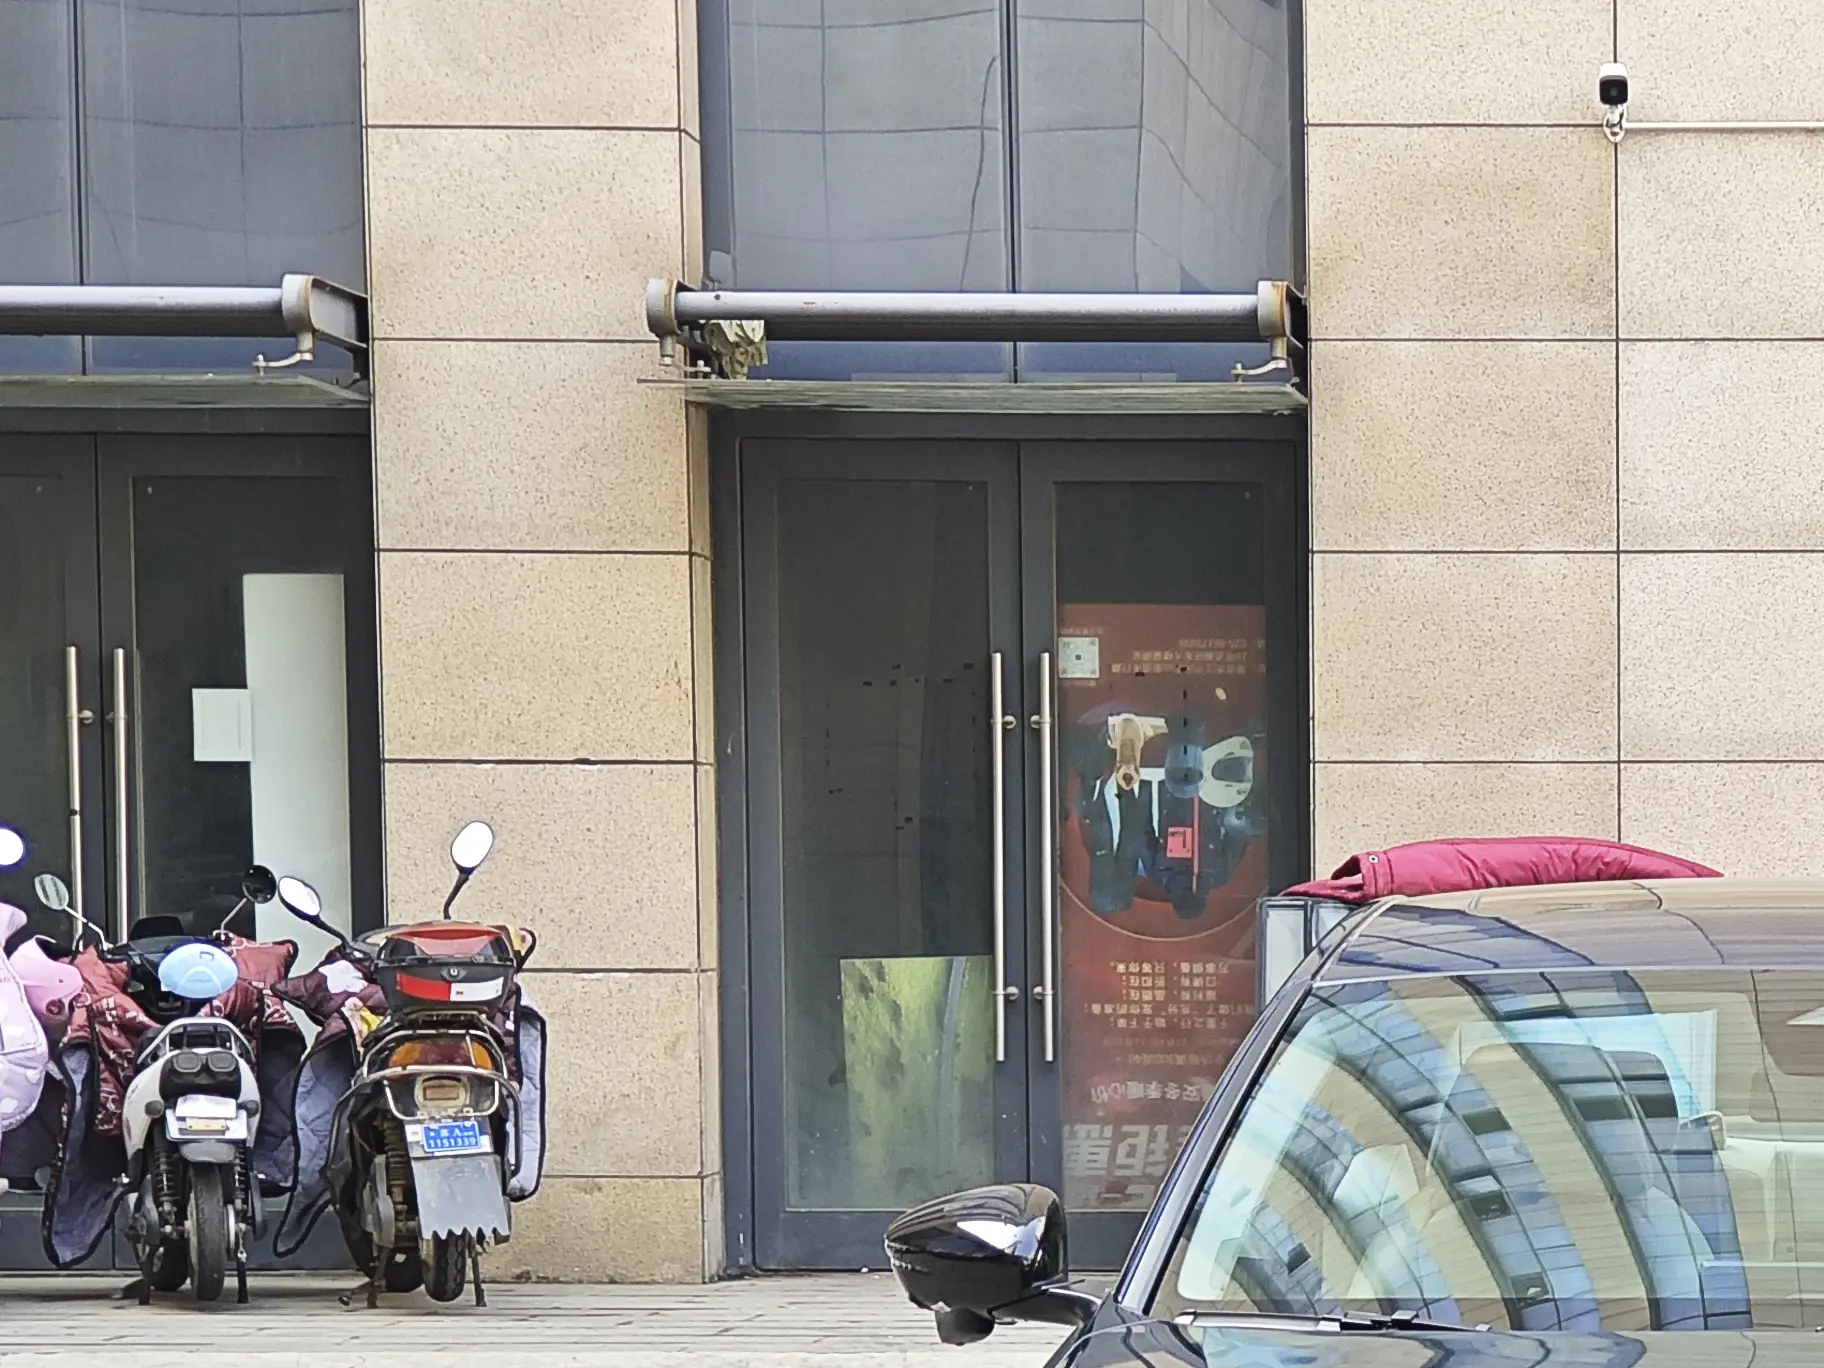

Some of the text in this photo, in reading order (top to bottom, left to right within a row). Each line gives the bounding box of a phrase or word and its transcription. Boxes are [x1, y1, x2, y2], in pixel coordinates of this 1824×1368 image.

[1091, 1081, 1215, 1105] 安冬季暖心价
[1060, 1124, 1192, 1177] 钜惠
